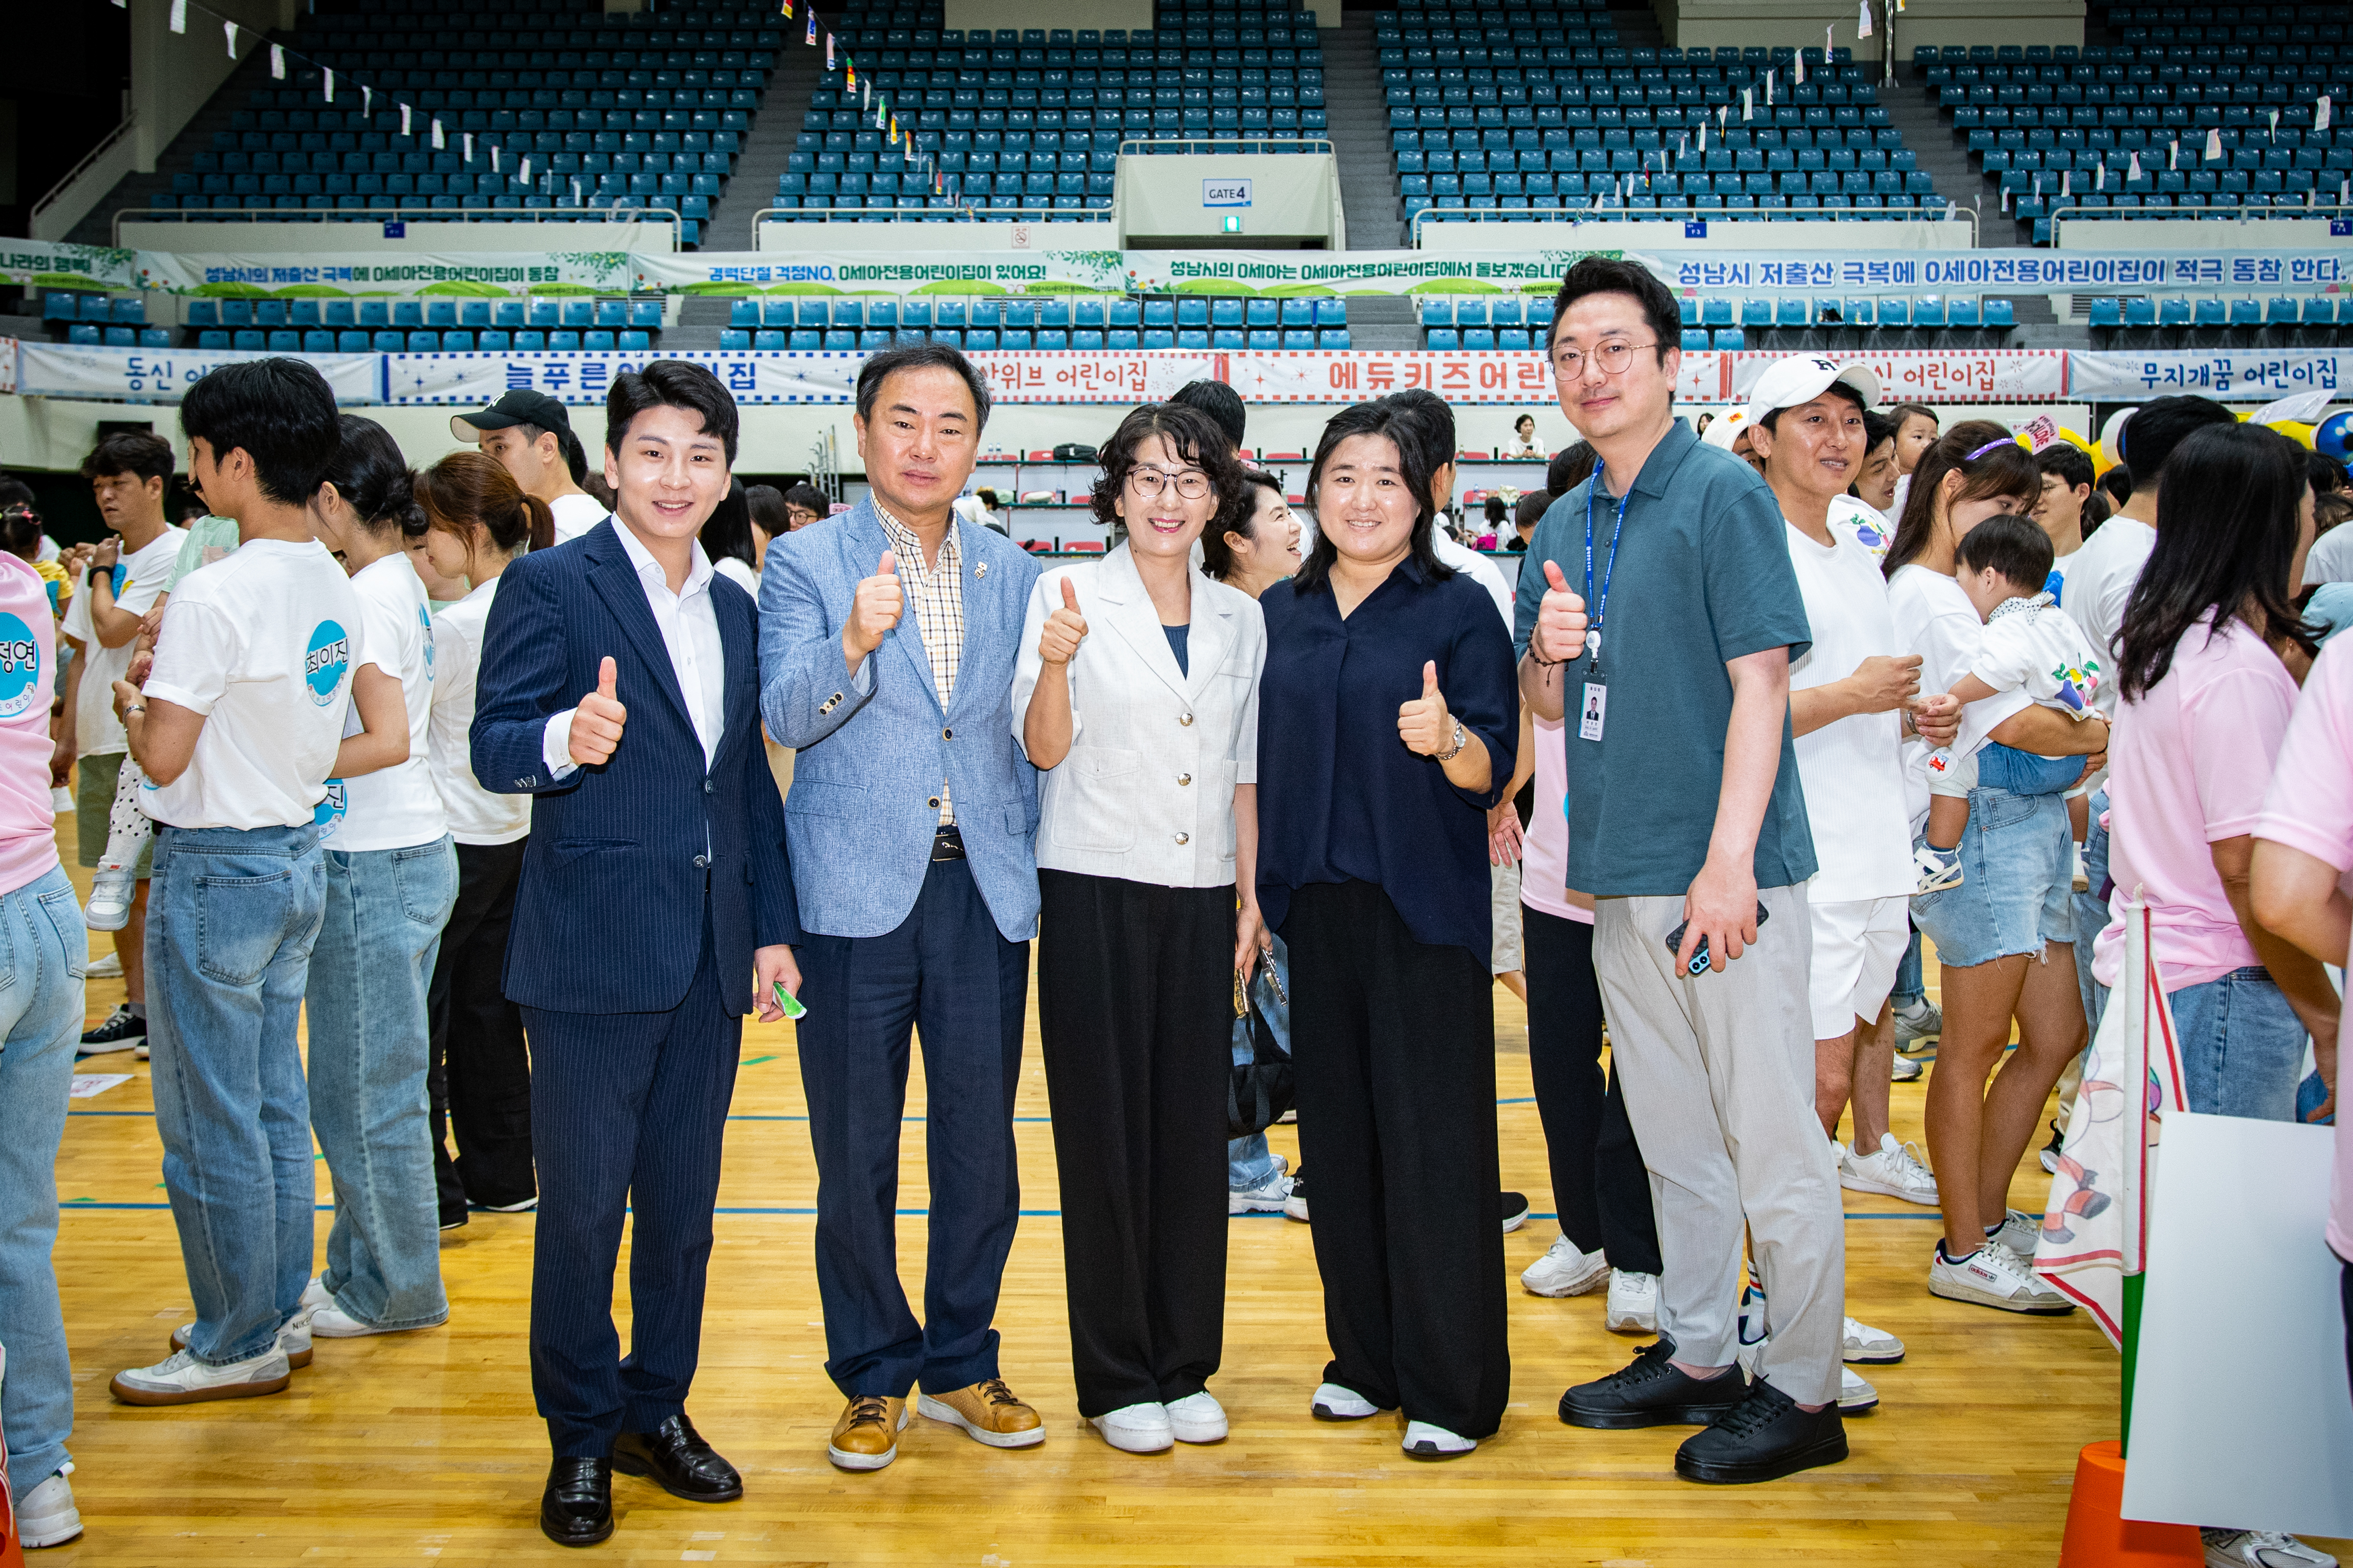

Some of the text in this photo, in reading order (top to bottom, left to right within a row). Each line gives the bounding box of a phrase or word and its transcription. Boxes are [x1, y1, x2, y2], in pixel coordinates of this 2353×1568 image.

[528, 267, 560, 283] 동참
[708, 267, 771, 282] 경력단절
[839, 265, 991, 281] 0세아전용어린이집이
[996, 265, 1047, 281] 있어요!
[1170, 261, 1234, 277] 성남시의
[1237, 263, 1297, 279] 0세아는
[1301, 262, 1472, 279] 0세아전용어린이집에서
[1678, 258, 2347, 286] 성남시 저출산 극복에 0세아전용어린이집이 적극 동참 한다.
[124, 357, 172, 391] 동신
[980, 360, 1148, 392] 산위브 어린이집
[1329, 362, 1546, 391] 에듀키즈어린
[1903, 359, 1995, 391] 어린이집
[2140, 357, 2337, 391] 무지개꿈 어린이집
[306, 638, 348, 674] 최이진
[1970, 1266, 1988, 1278] adidas
